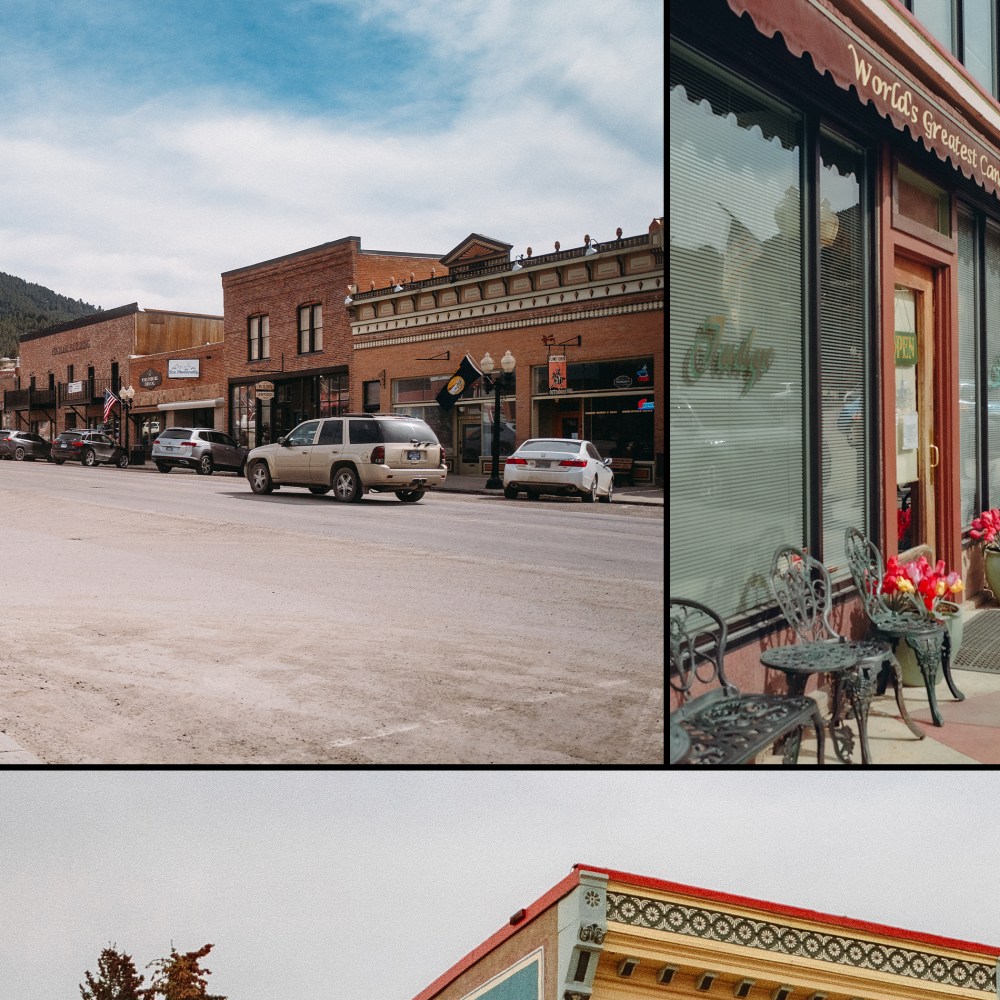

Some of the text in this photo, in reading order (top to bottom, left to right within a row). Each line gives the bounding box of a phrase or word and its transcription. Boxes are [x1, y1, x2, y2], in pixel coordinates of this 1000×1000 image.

[847, 43, 919, 124] World's
[922, 110, 978, 169] Greatest
[895, 335, 915, 359] PEN
